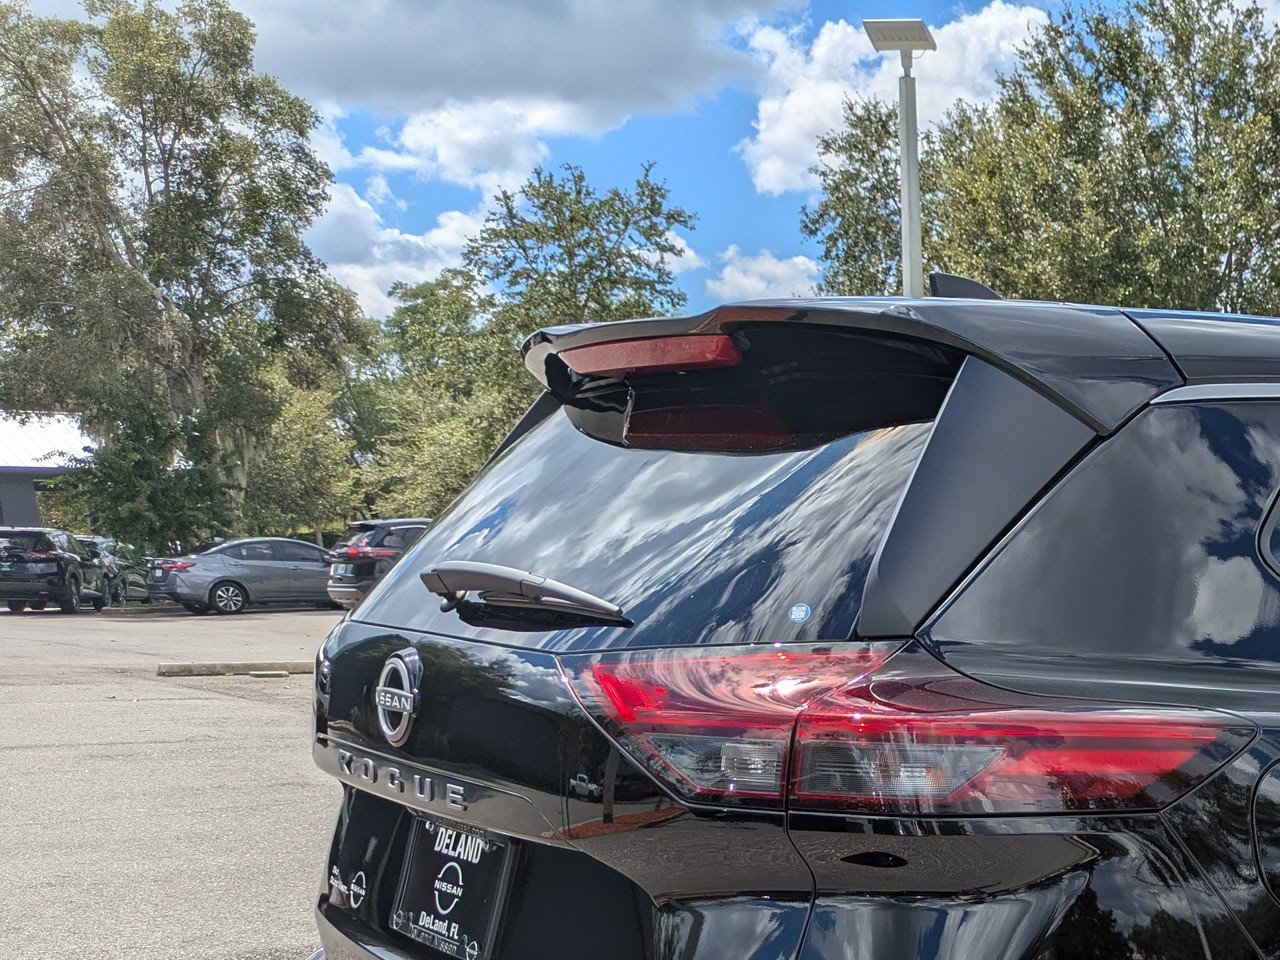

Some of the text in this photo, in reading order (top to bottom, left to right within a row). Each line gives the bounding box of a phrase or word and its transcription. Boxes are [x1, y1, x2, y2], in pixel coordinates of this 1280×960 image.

[338, 748, 465, 810] ROGUE
[434, 826, 483, 865] DELAND
[434, 879, 464, 898] NISSAN
[418, 910, 460, 940] DeLand, FL
